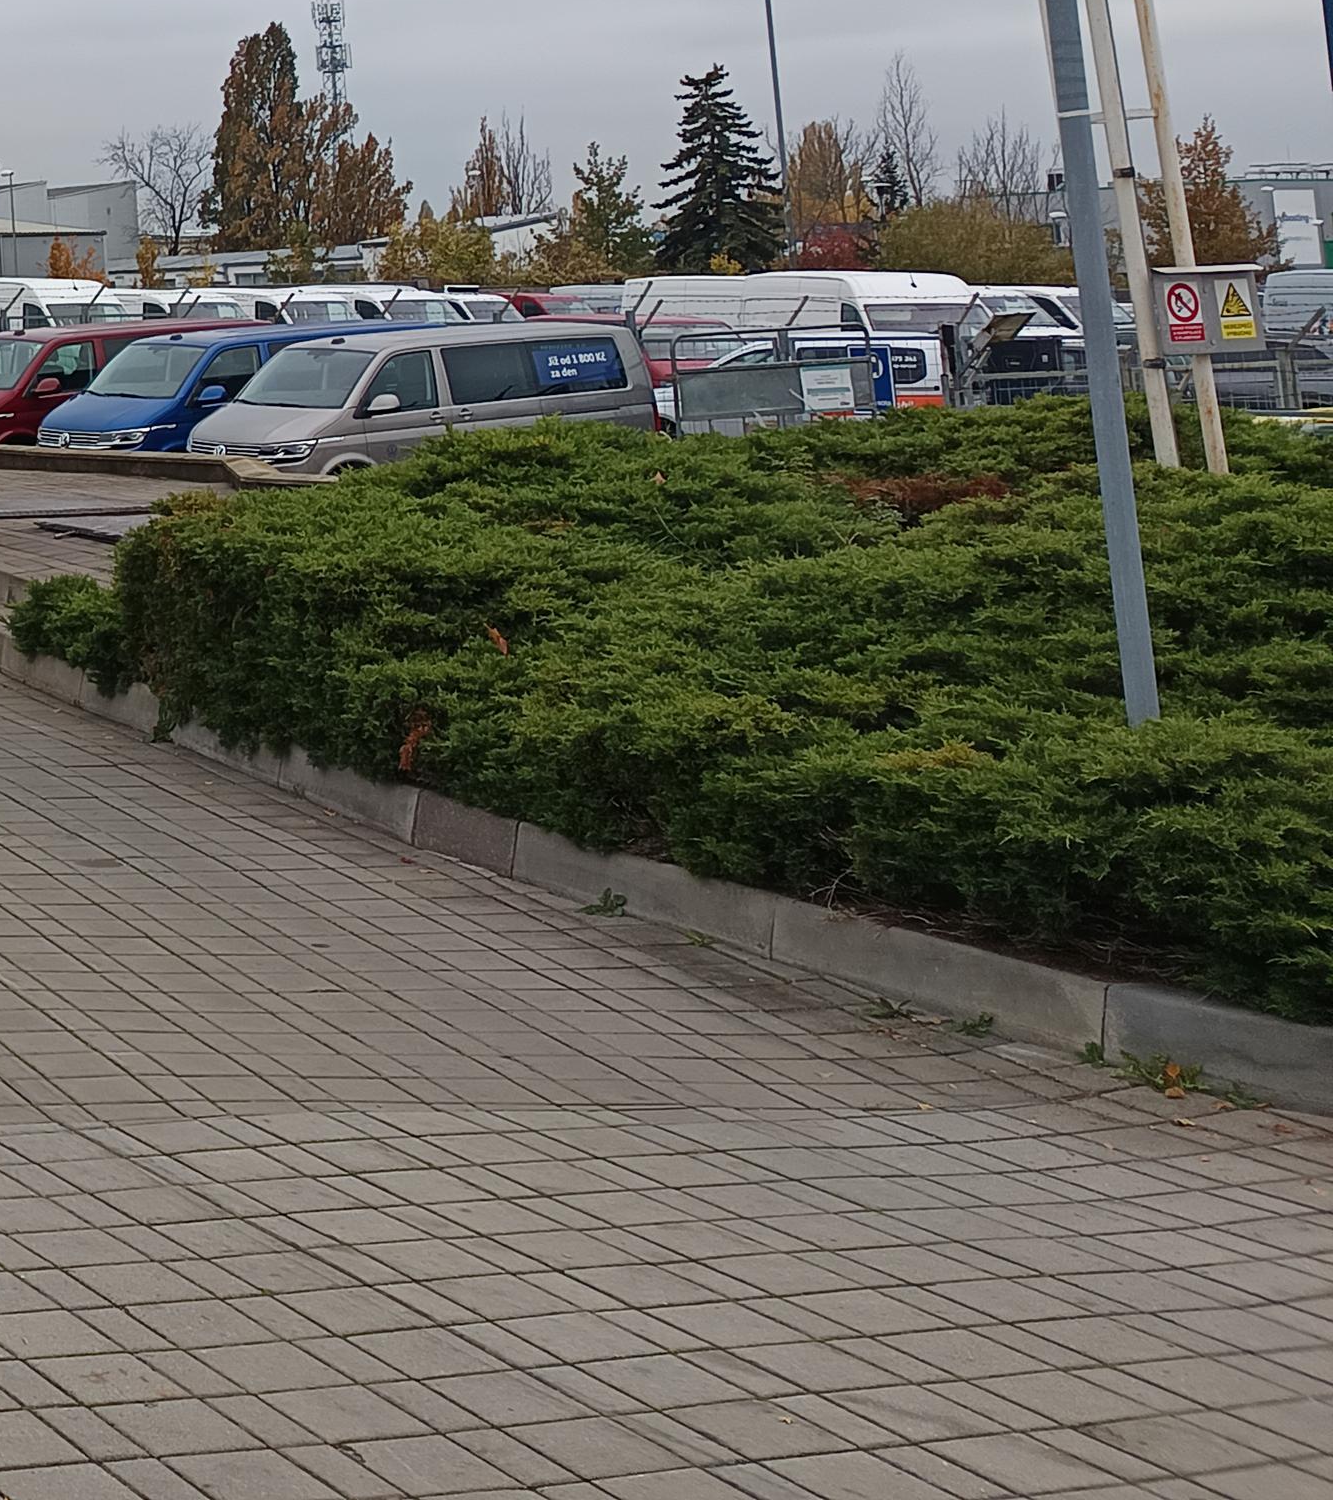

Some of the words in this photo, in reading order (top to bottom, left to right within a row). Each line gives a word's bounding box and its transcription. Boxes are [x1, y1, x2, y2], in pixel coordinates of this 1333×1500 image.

[560, 355, 571, 365] od
[595, 351, 607, 362] Kč
[550, 370, 561, 378] za
[561, 367, 578, 377] den
